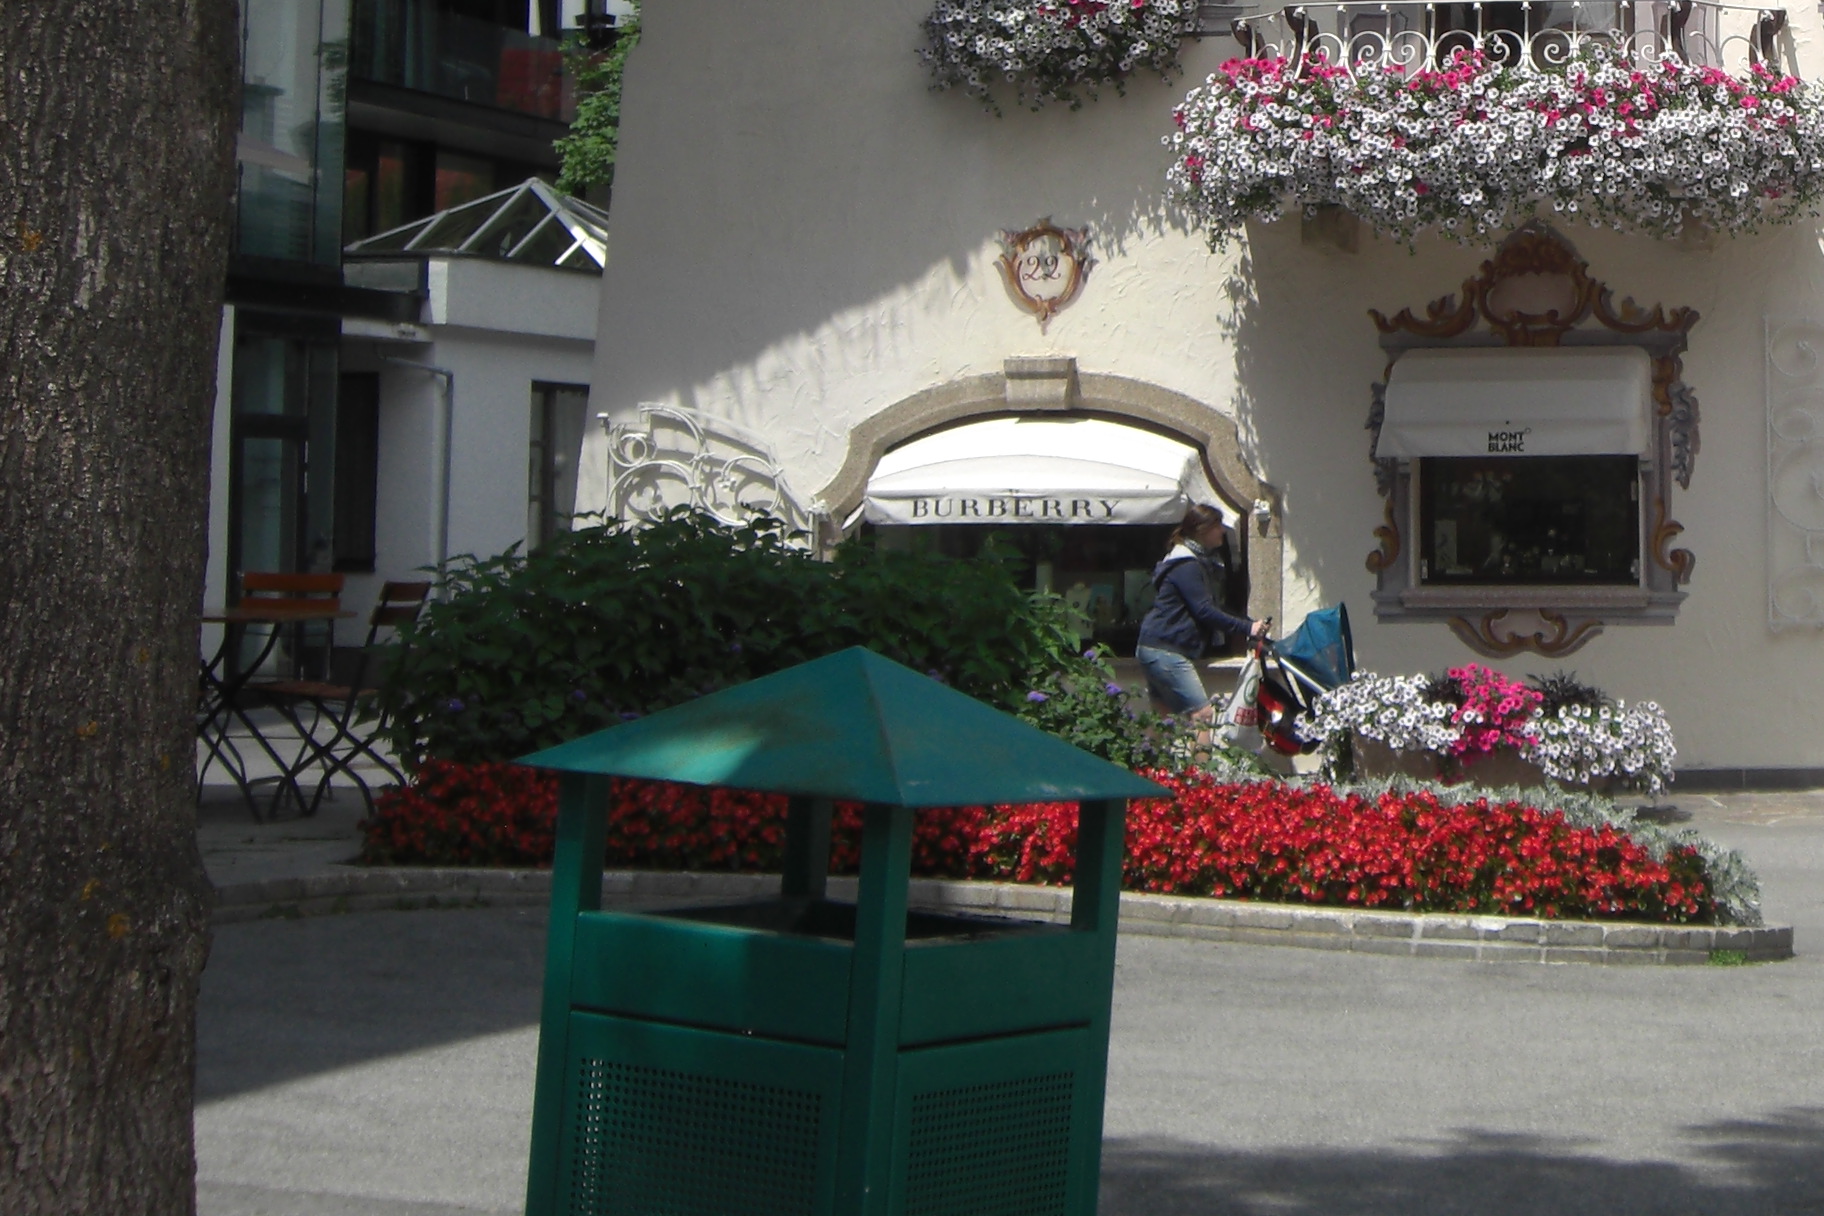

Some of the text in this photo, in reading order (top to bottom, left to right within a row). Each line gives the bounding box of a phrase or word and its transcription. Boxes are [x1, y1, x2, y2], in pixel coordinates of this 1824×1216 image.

[1021, 255, 1062, 282] 22
[1488, 431, 1525, 441] MONT
[1488, 442, 1525, 452] BLANC
[911, 498, 1121, 519] BURBERRY
